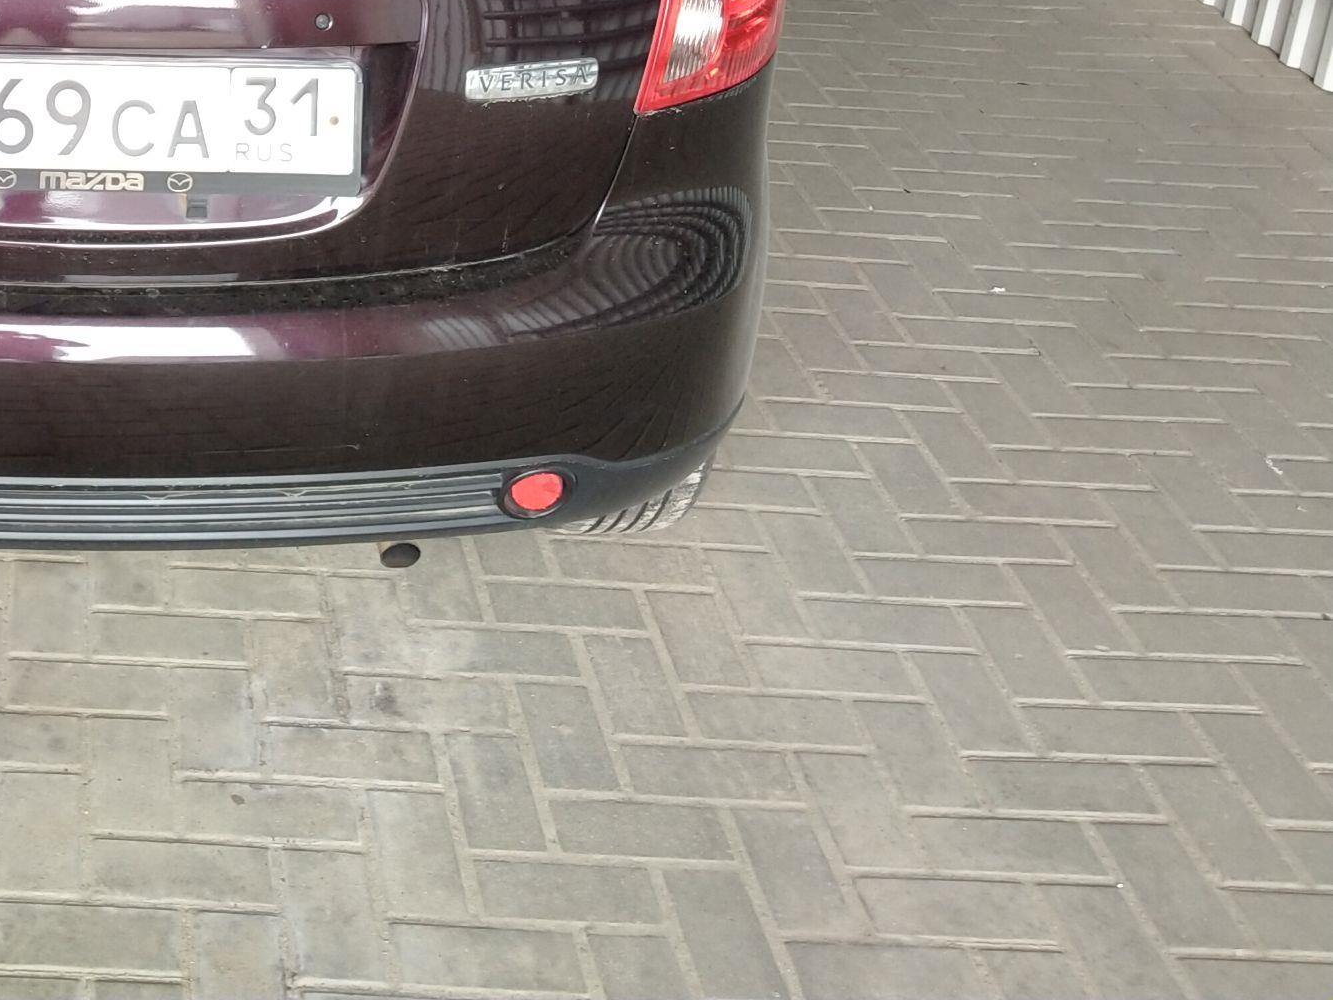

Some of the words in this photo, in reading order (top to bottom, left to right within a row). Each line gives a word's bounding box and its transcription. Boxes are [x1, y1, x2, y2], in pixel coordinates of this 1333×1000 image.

[478, 65, 589, 93] VERISA
[243, 76, 319, 137] 31
[234, 142, 294, 163] RUS
